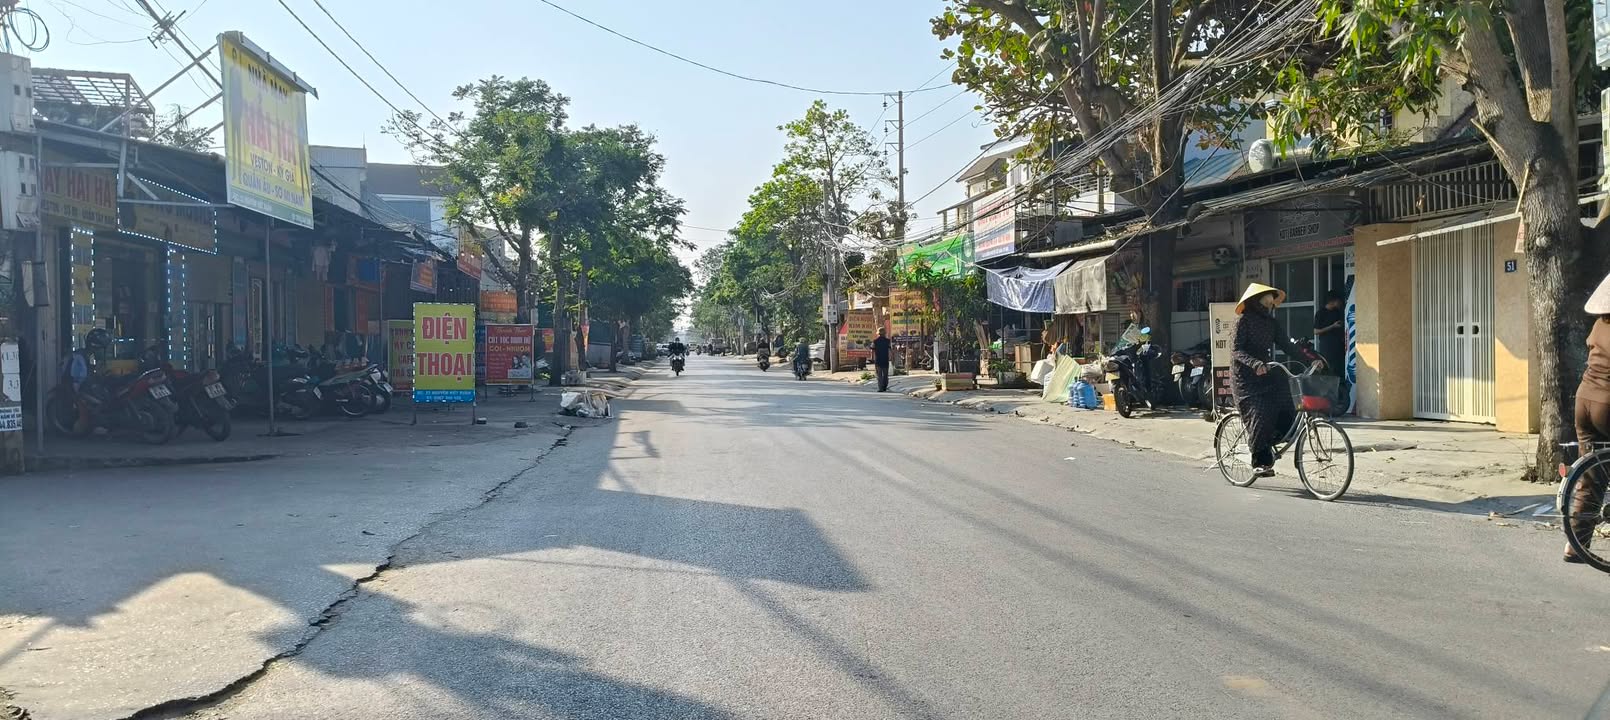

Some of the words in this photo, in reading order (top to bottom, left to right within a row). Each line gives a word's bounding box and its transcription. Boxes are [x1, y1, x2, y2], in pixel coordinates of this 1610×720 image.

[1307, 223, 1320, 234] SHOP
[1506, 261, 1515, 271] 51
[422, 312, 467, 345] ĐIỆN
[1215, 340, 1227, 349] KOT
[417, 352, 472, 381] THOẠI
